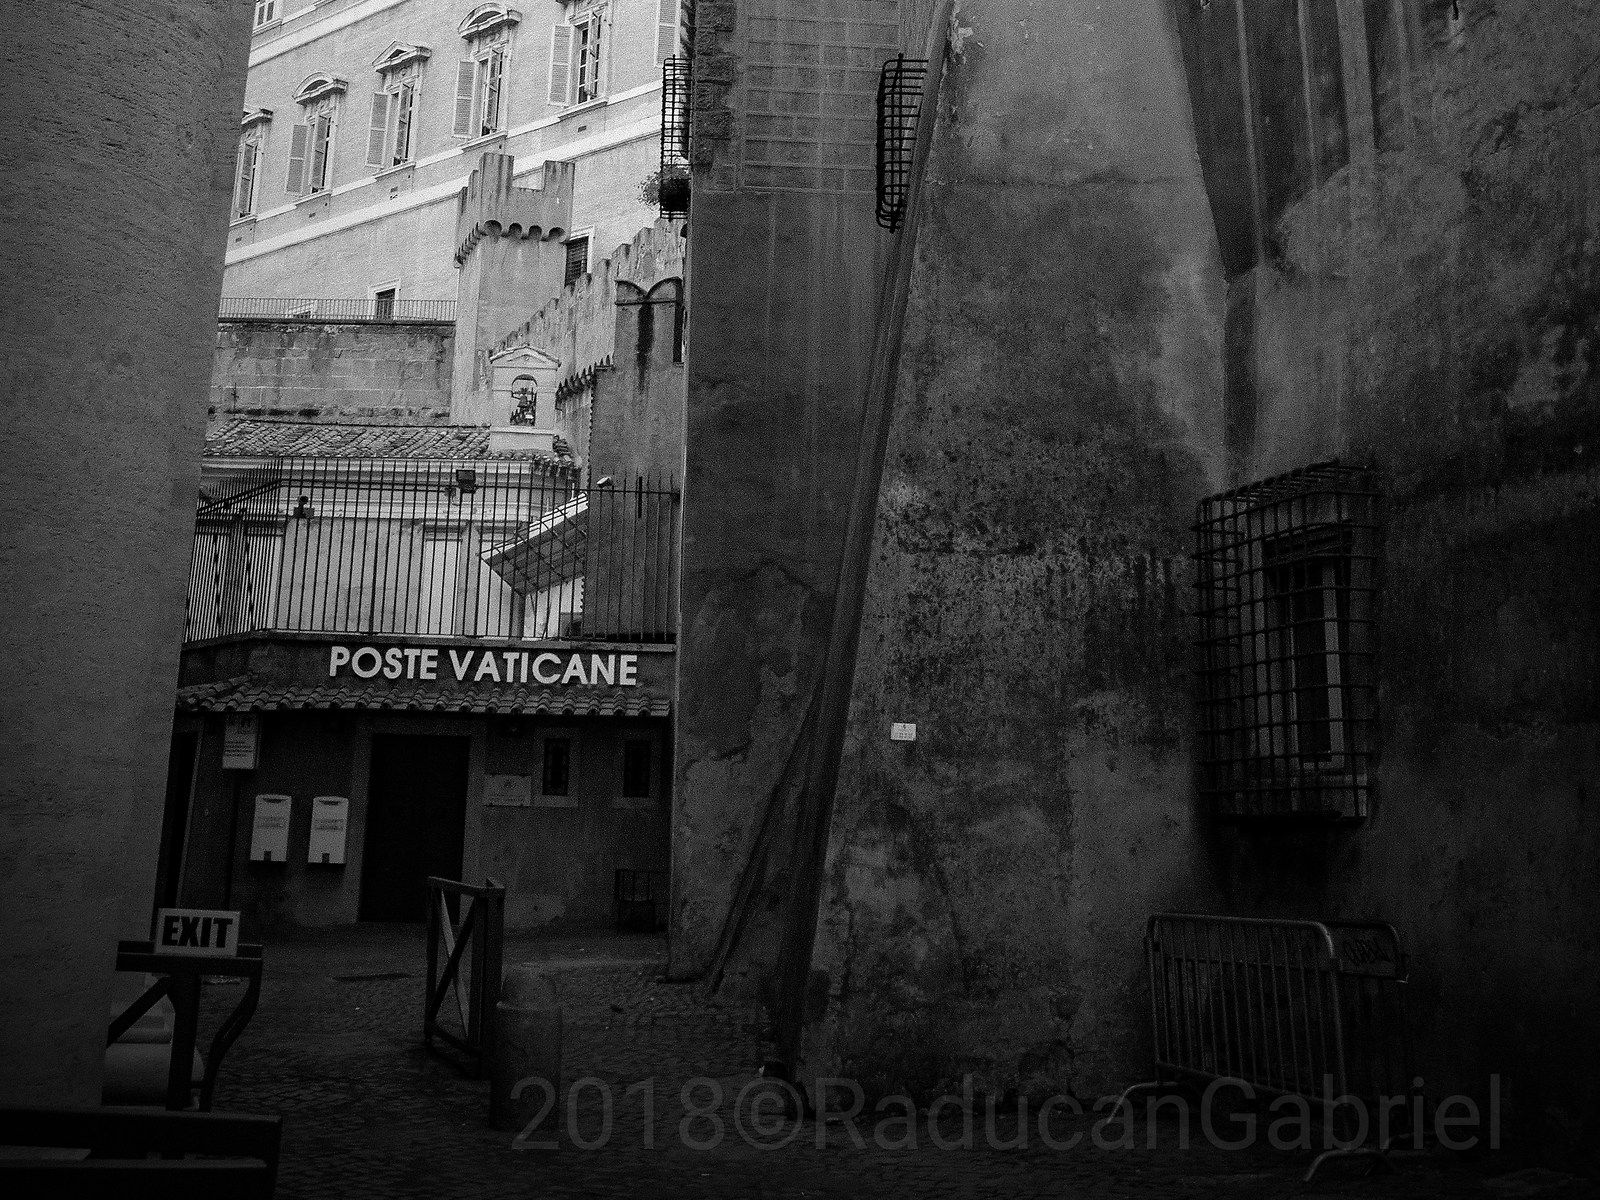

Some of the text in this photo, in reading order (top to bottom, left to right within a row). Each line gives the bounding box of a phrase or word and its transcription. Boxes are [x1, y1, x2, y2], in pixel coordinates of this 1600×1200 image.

[329, 646, 638, 686] POSTE VATICANE
[162, 915, 233, 948] EXIT
